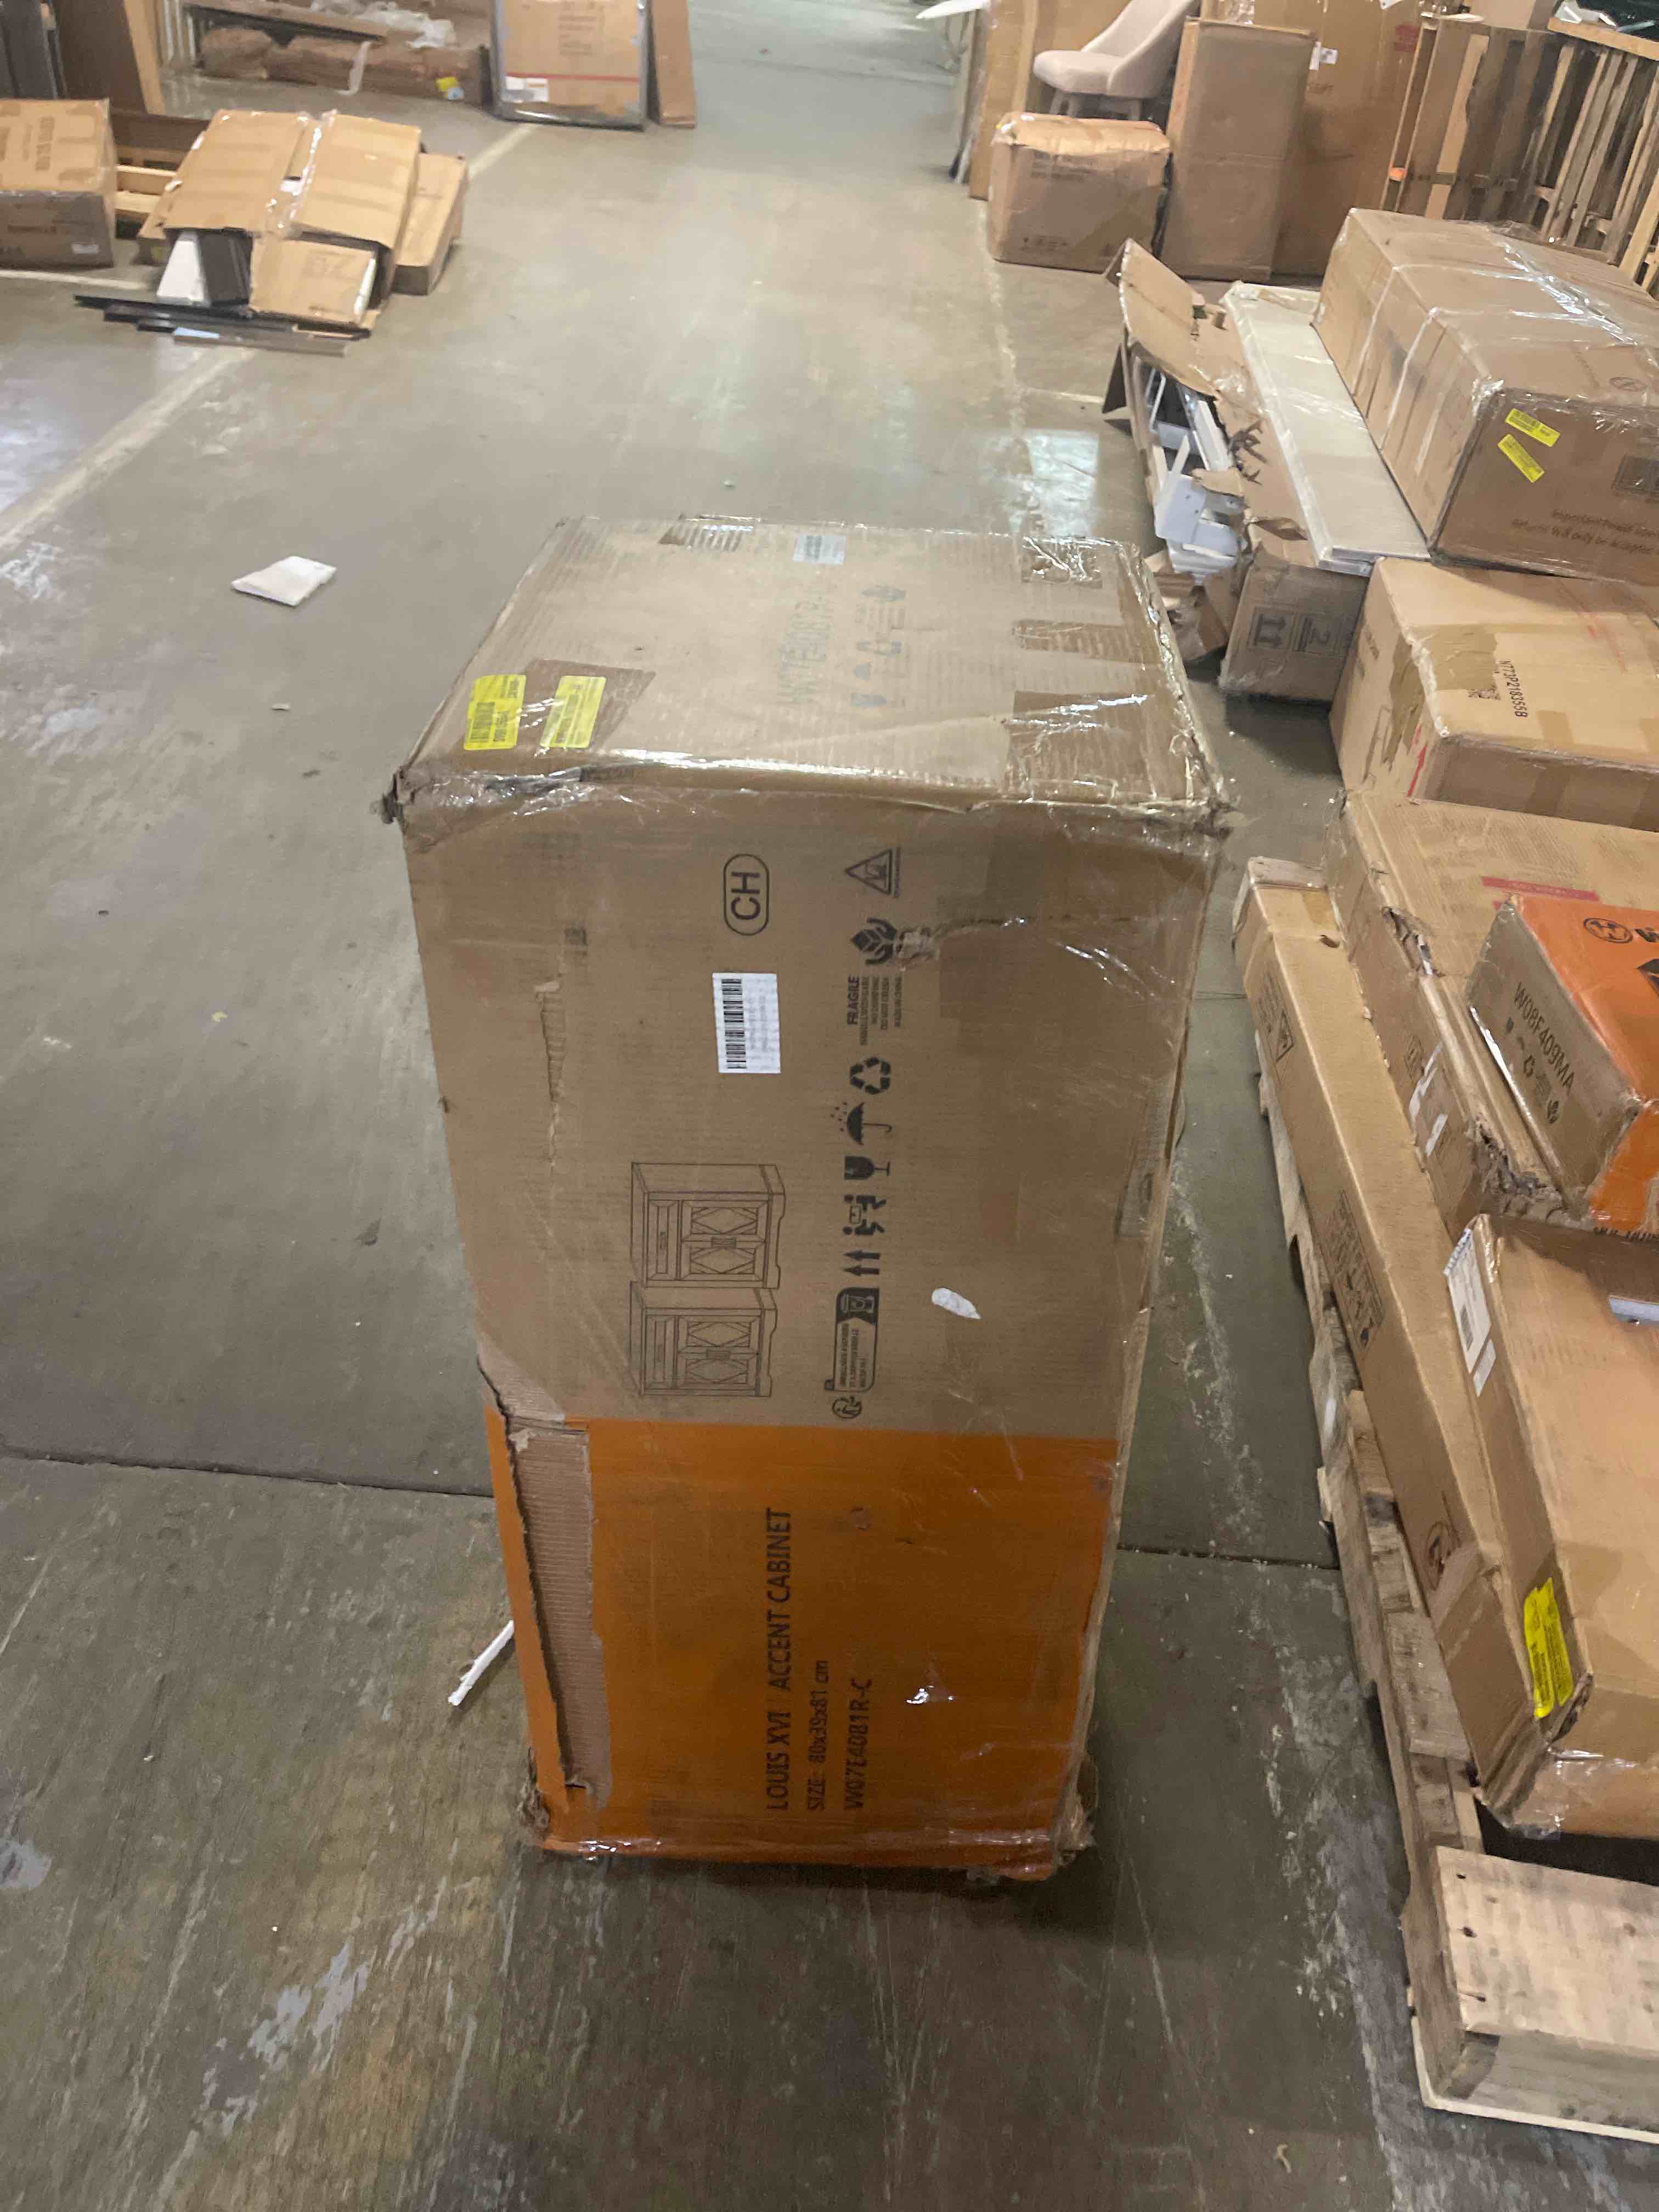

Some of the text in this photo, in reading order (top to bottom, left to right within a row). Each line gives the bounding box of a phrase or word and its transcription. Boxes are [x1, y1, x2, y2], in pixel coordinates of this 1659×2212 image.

[730, 871, 760, 921] CH
[847, 976, 860, 1025] FRAGILE
[765, 1507, 791, 1810] LOUIS XVI ACCENT CABINET
[815, 1660, 830, 1684] cm
